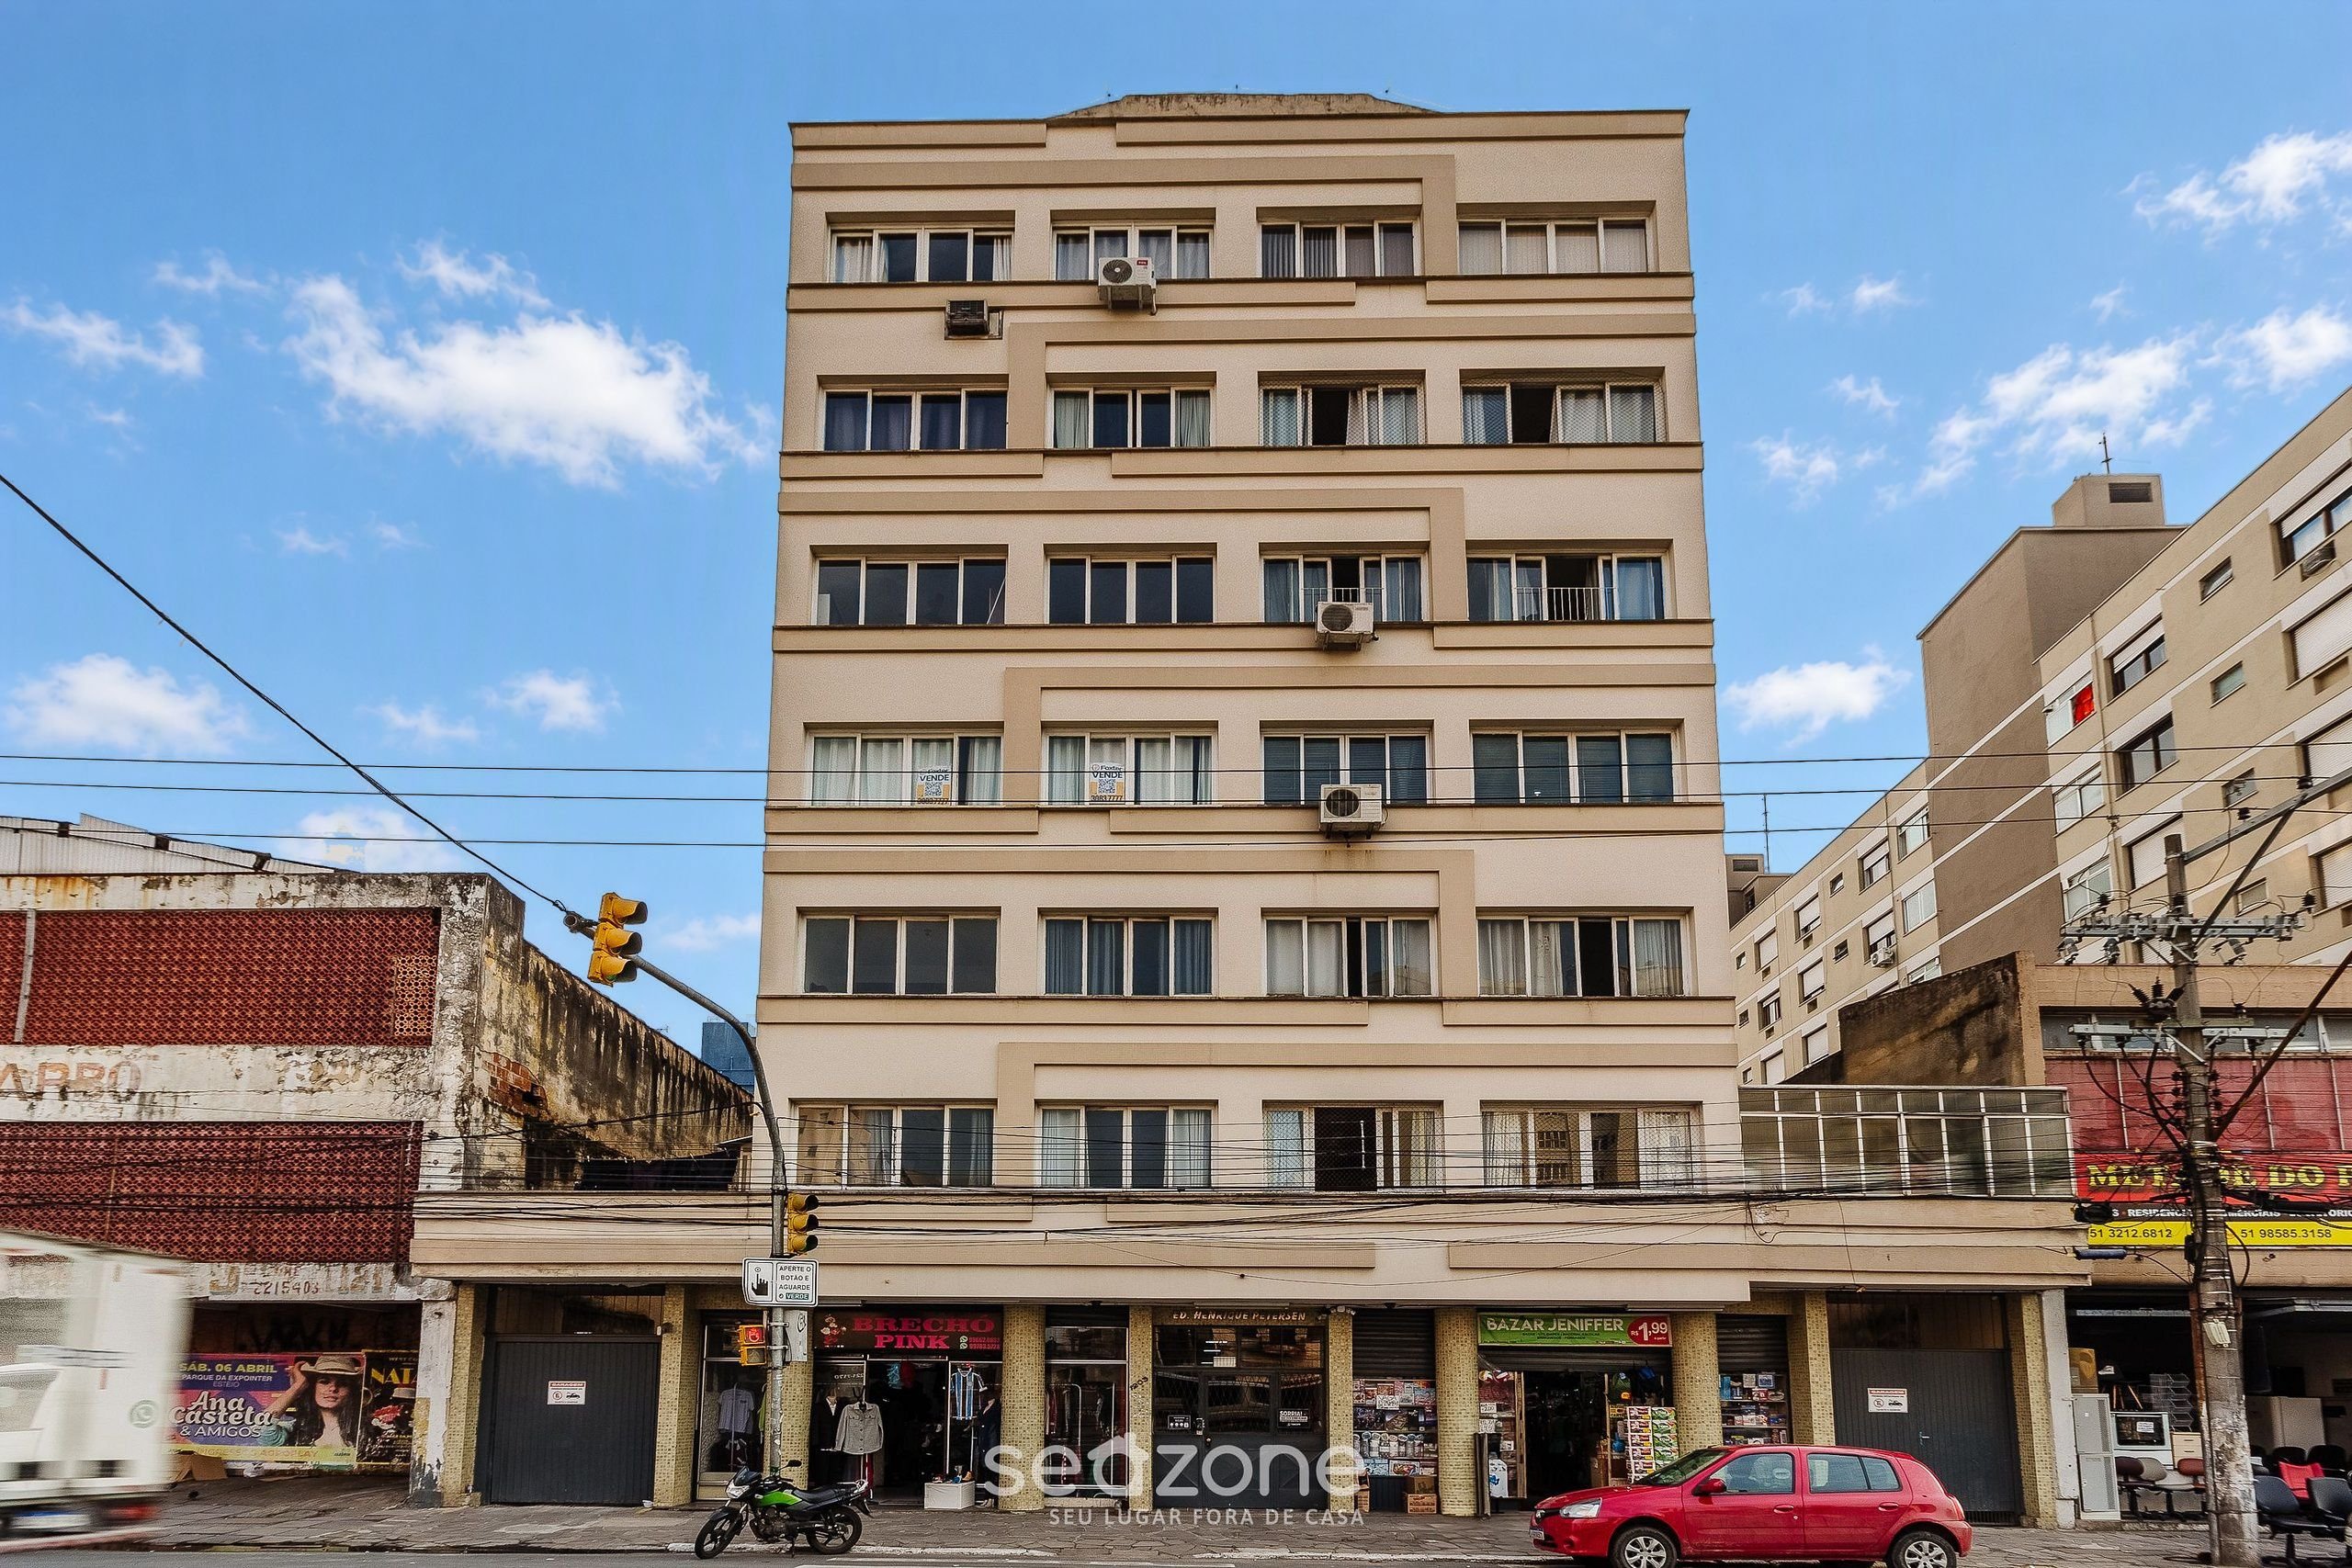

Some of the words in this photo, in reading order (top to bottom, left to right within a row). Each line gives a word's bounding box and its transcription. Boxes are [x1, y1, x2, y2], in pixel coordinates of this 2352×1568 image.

[919, 773, 950, 782] VENDE
[2268, 1164, 2325, 1187] DO
[2089, 1229, 2104, 1238] 51
[2109, 1228, 2172, 1238] 3212.6812
[2240, 1229, 2255, 1238] 51
[2259, 1229, 2332, 1238] 98585.3158
[853, 1314, 995, 1332] BRECHÓ
[1252, 1312, 1306, 1321] PETERSEN
[1487, 1317, 1544, 1331] BAZAR
[1548, 1317, 1625, 1332] JENIFFER
[1638, 1322, 1668, 1341] 1,99
[875, 1335, 950, 1349] PINK
[215, 1363, 232, 1372] 06
[235, 1364, 277, 1373] ABRIL
[188, 1391, 245, 1411] Ana
[168, 1405, 273, 1427] Castela
[179, 1426, 193, 1437] &
[195, 1426, 262, 1438] AMIGOS
